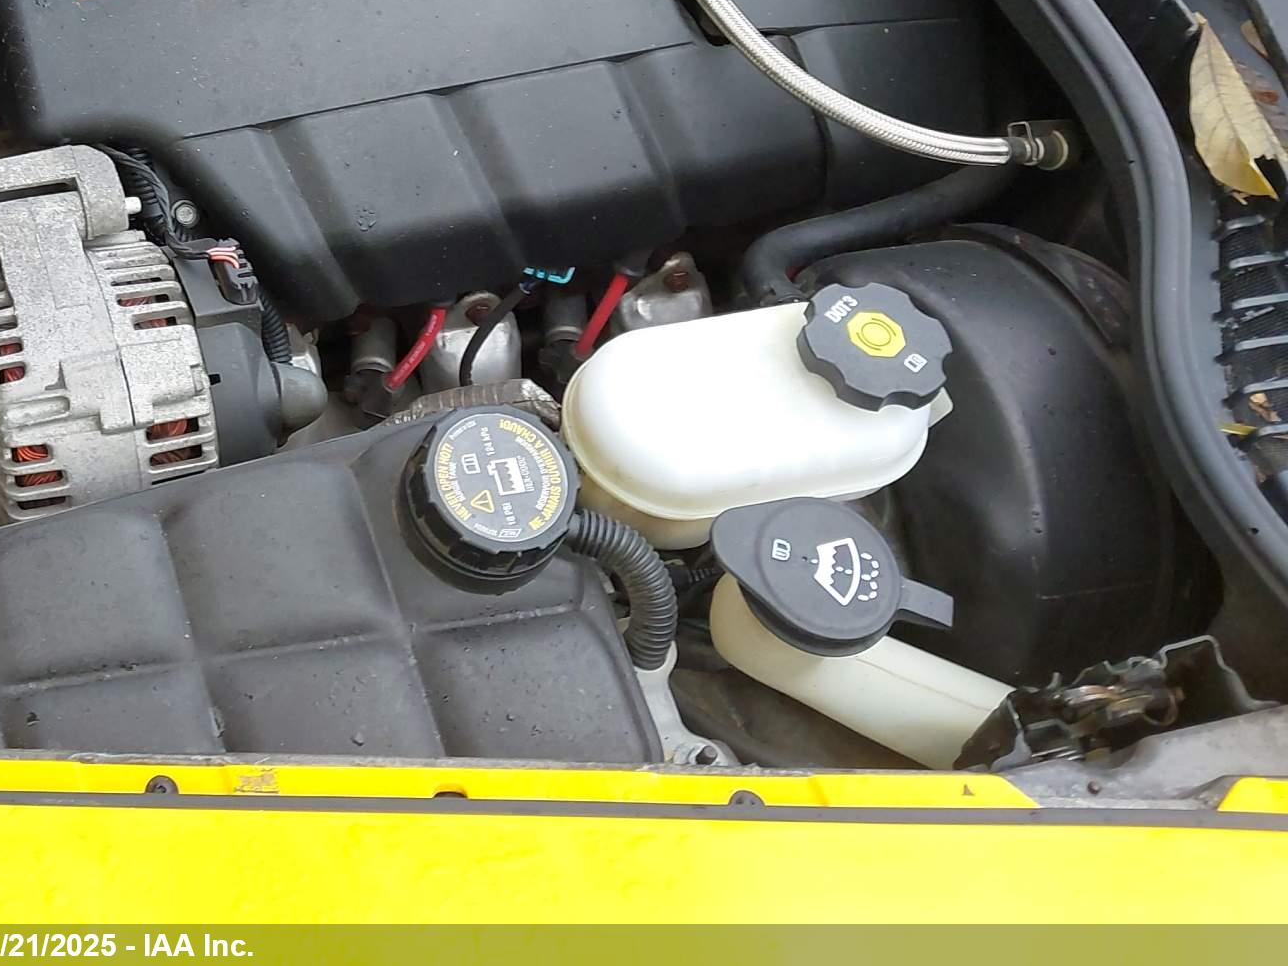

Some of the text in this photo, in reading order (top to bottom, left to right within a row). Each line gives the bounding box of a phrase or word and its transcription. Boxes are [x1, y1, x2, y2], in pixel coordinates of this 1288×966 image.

[824, 295, 859, 324] DOT 3
[499, 419, 537, 443] CHAUD!
[437, 465, 453, 491] OPEN
[540, 448, 562, 484] OUVRIR
[444, 491, 473, 521] NEVER
[502, 502, 514, 515] PSI
[541, 486, 562, 521] JAMAIS
[529, 515, 545, 530] NE
